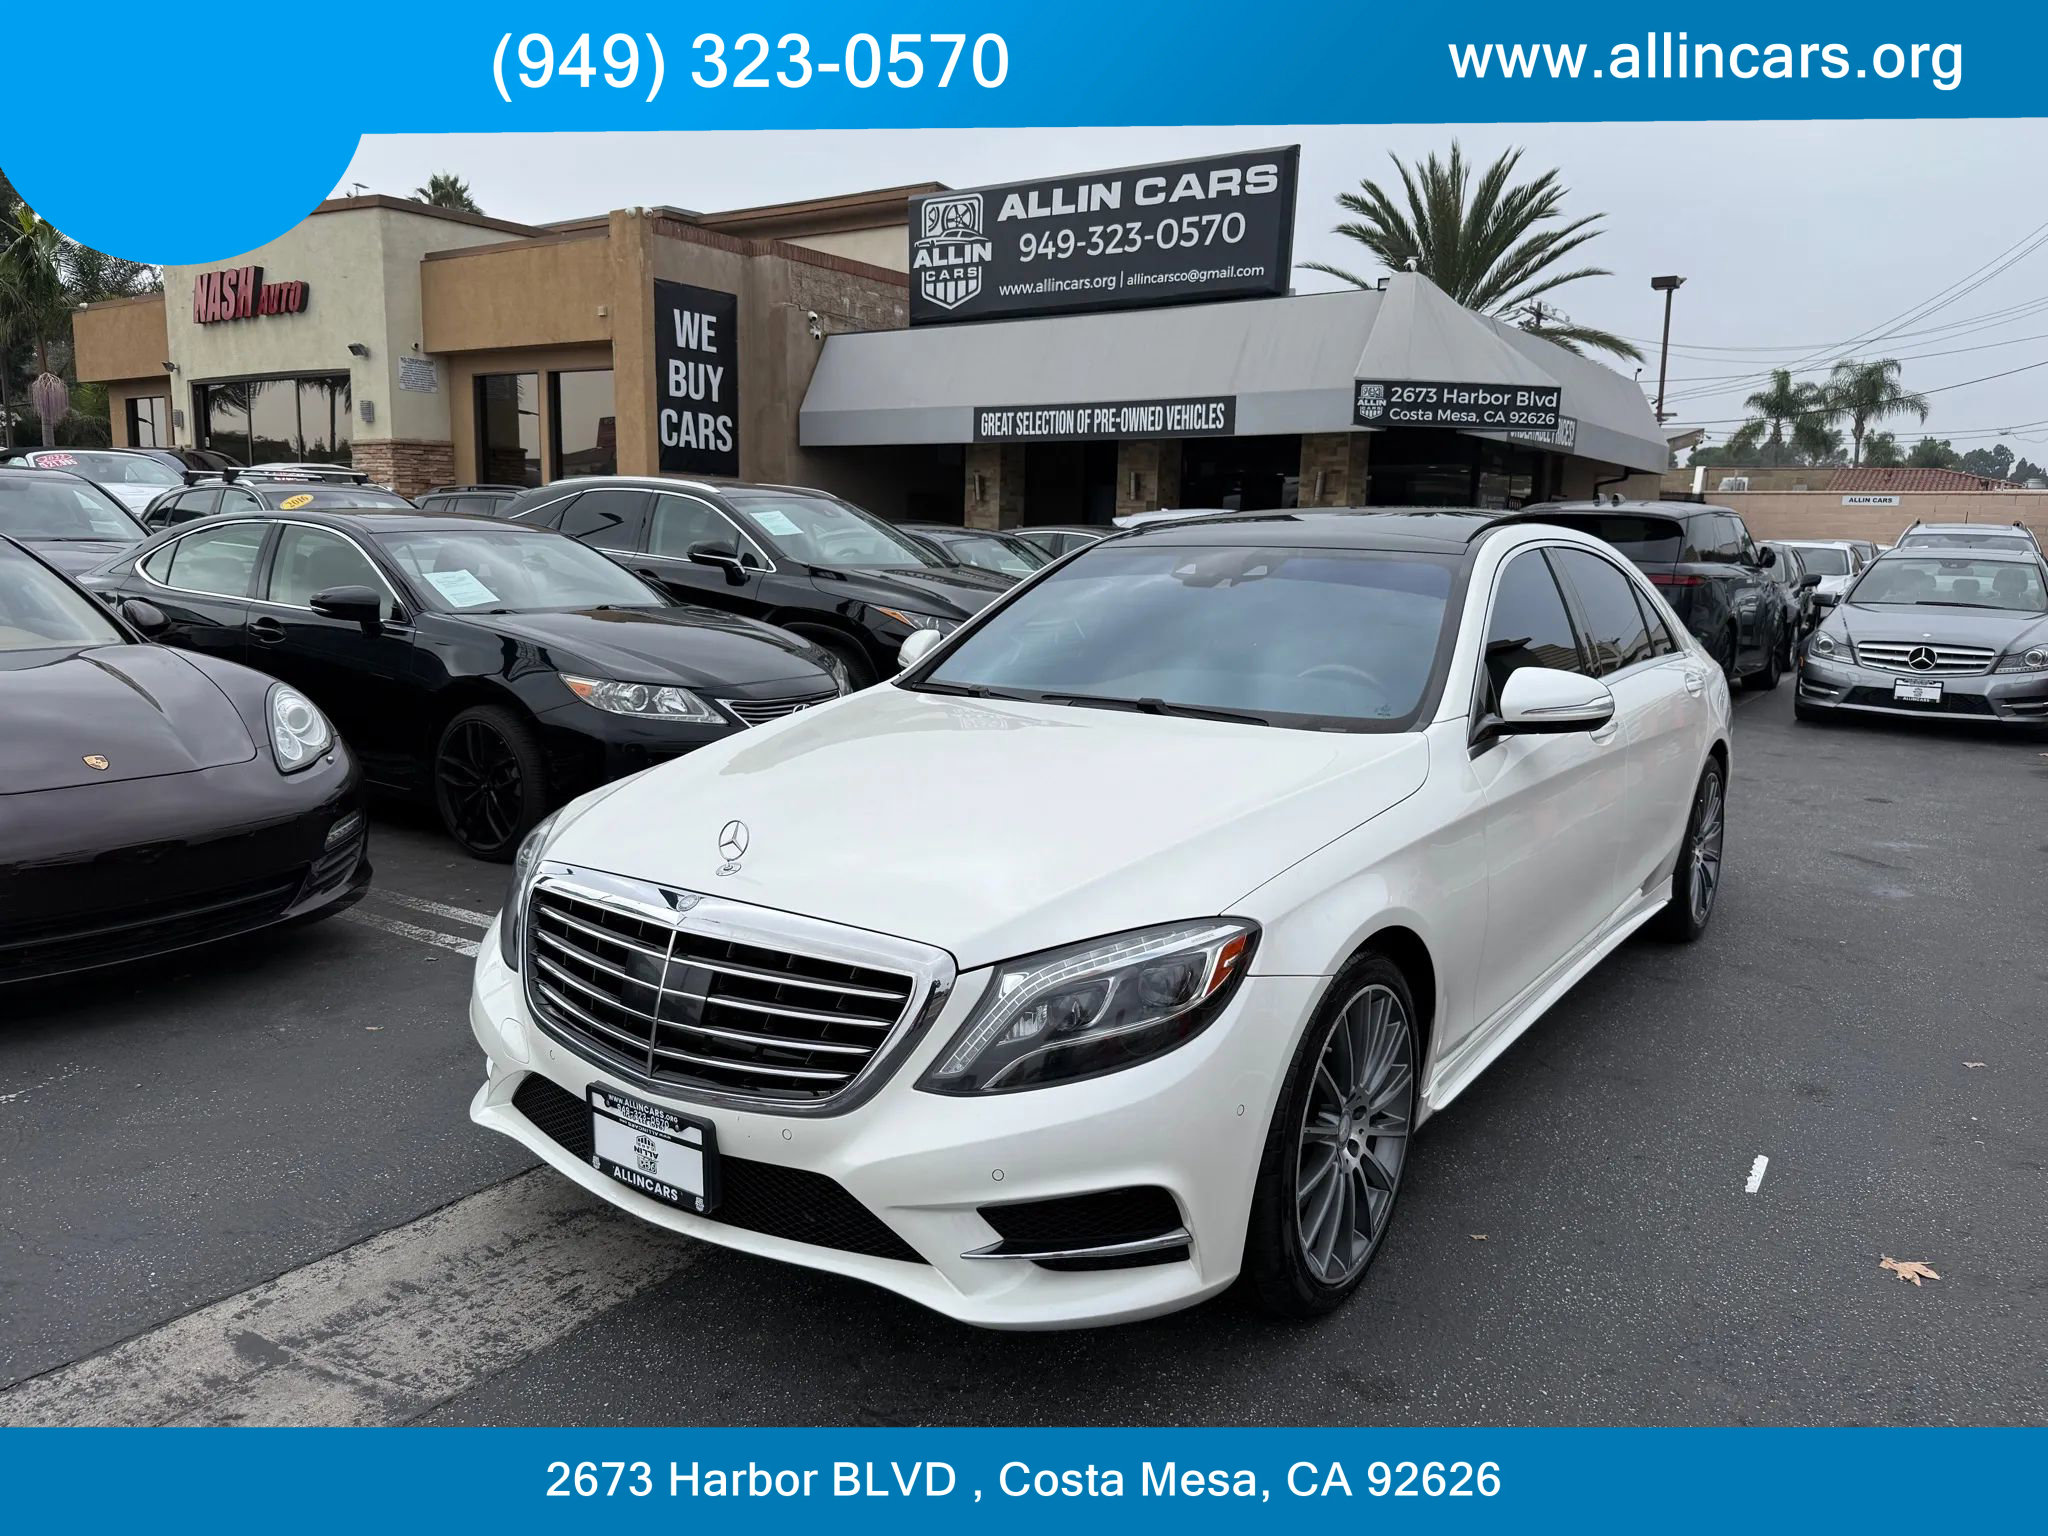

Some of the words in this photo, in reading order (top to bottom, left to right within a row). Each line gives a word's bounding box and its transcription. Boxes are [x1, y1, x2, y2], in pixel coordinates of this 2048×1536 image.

[997, 181, 1122, 222] ALLIN
[1134, 163, 1279, 206] CARS
[1019, 212, 1246, 263] 949-323-0570
[913, 242, 992, 269] ALLIN
[925, 267, 978, 281] CARS
[999, 274, 1117, 296] www.allincars.org
[1126, 264, 1265, 286] allincarsco@gmail.com
[193, 265, 261, 323] NASH
[257, 280, 305, 315] AUTO
[673, 308, 718, 353] WE
[668, 358, 724, 403] BUY
[1390, 387, 1437, 403] 2673
[1443, 389, 1512, 406] Harbor
[1516, 391, 1558, 408] Blvd
[660, 408, 733, 453] CARS
[980, 412, 1015, 436] GREAT
[1015, 409, 1074, 435] SELECTION
[1076, 409, 1092, 433] OF
[1094, 405, 1163, 433] PRE-OWNED
[1166, 402, 1226, 430] VEHICLES
[1389, 408, 1433, 421] Costa
[1437, 410, 1480, 424] Mesa,
[1484, 411, 1505, 422] CA
[1509, 411, 1555, 425] 92626
[285, 495, 309, 508] 2016
[613, 1165, 679, 1201] ALLINCARS
